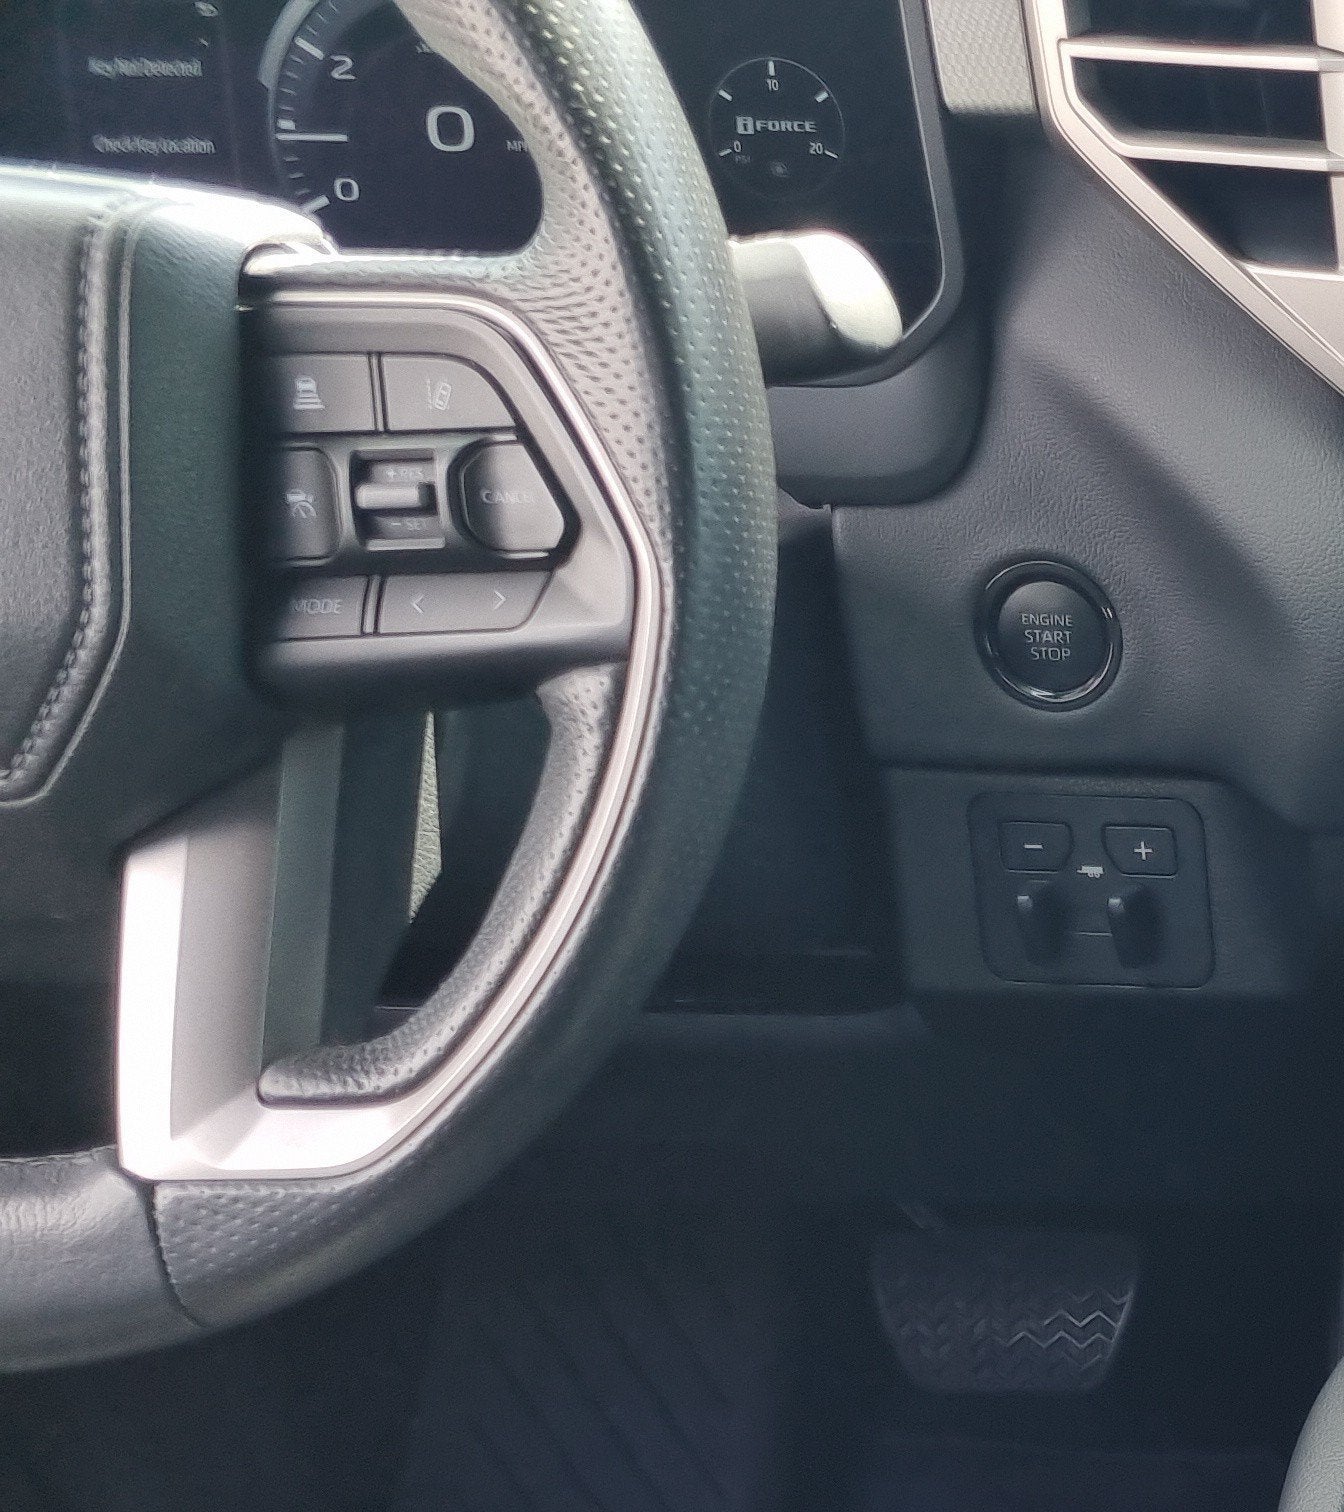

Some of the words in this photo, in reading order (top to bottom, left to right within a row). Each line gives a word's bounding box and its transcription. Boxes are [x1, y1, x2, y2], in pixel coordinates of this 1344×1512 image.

[331, 55, 357, 80] 2
[766, 79, 779, 91] 10
[426, 105, 475, 152] 0
[733, 140, 742, 153] 0
[808, 142, 823, 155] 20
[334, 177, 360, 201] 0
[1021, 613, 1073, 626] ENGINE
[1024, 629, 1072, 644] START
[1030, 646, 1071, 661] STOP
